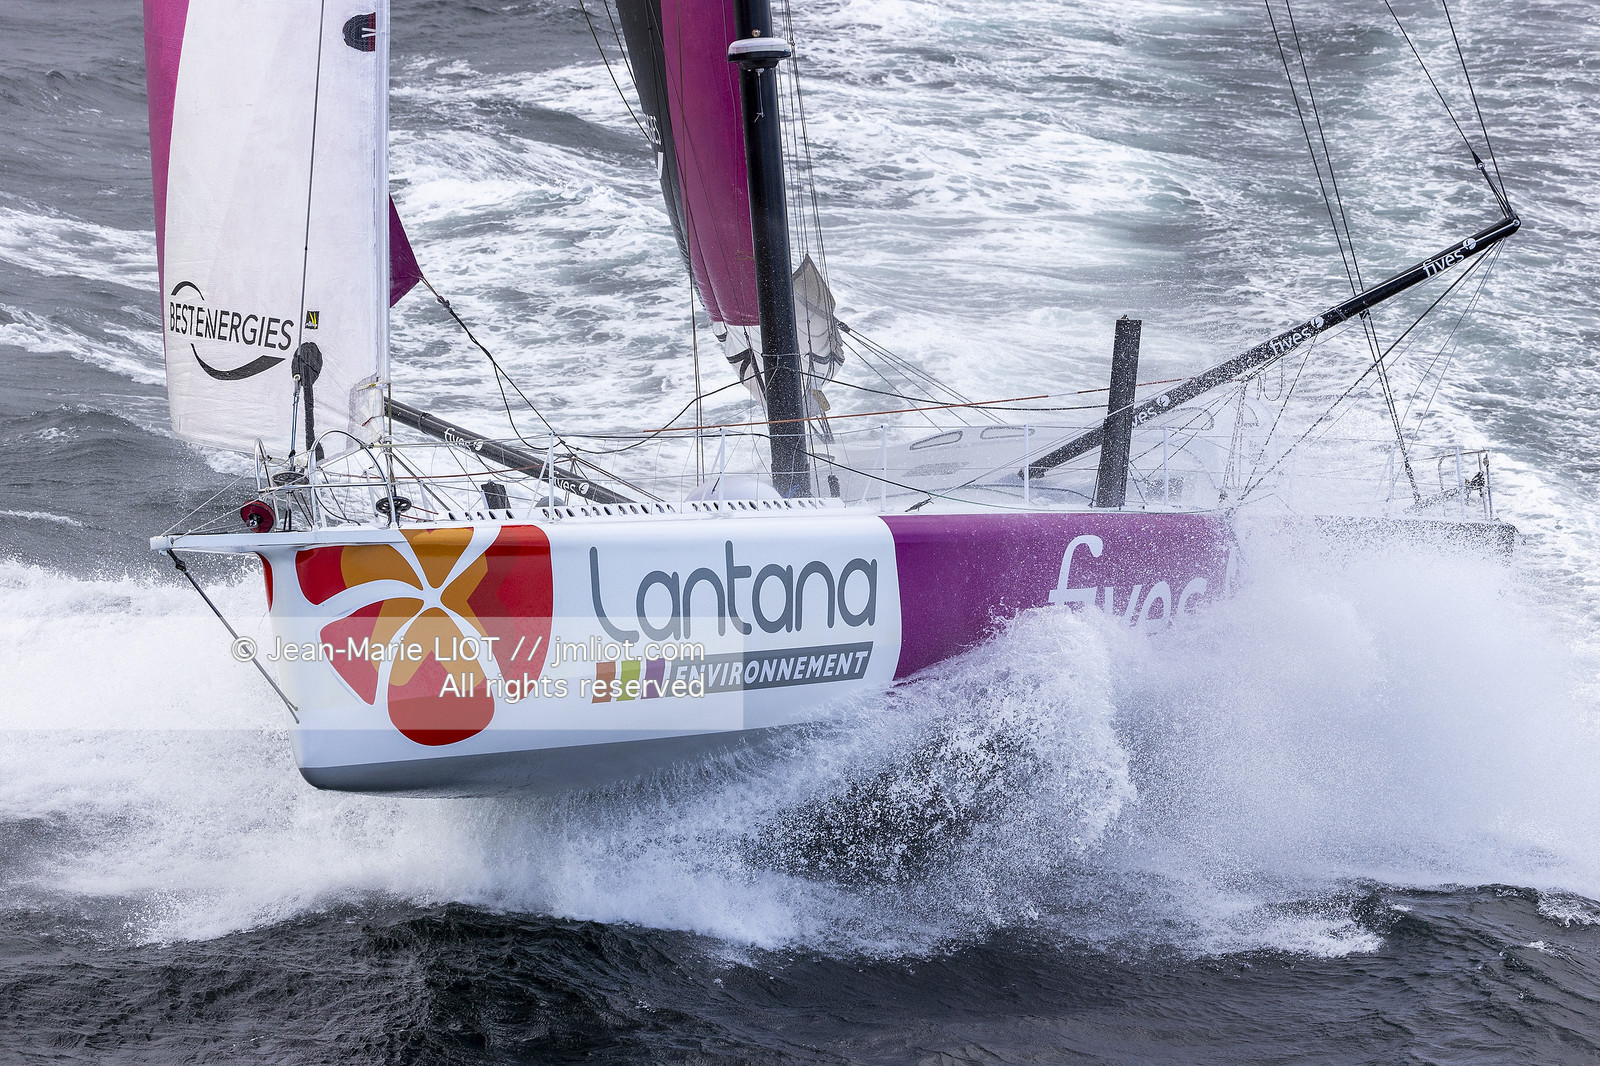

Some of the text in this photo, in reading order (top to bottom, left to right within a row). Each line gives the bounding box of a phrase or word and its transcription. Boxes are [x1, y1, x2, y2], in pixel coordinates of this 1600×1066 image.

[1423, 250, 1465, 277] fives
[1269, 327, 1312, 355] fives
[1132, 407, 1157, 427] ves
[553, 470, 577, 494] ives
[675, 650, 869, 688] ENVIRONNEMENT
